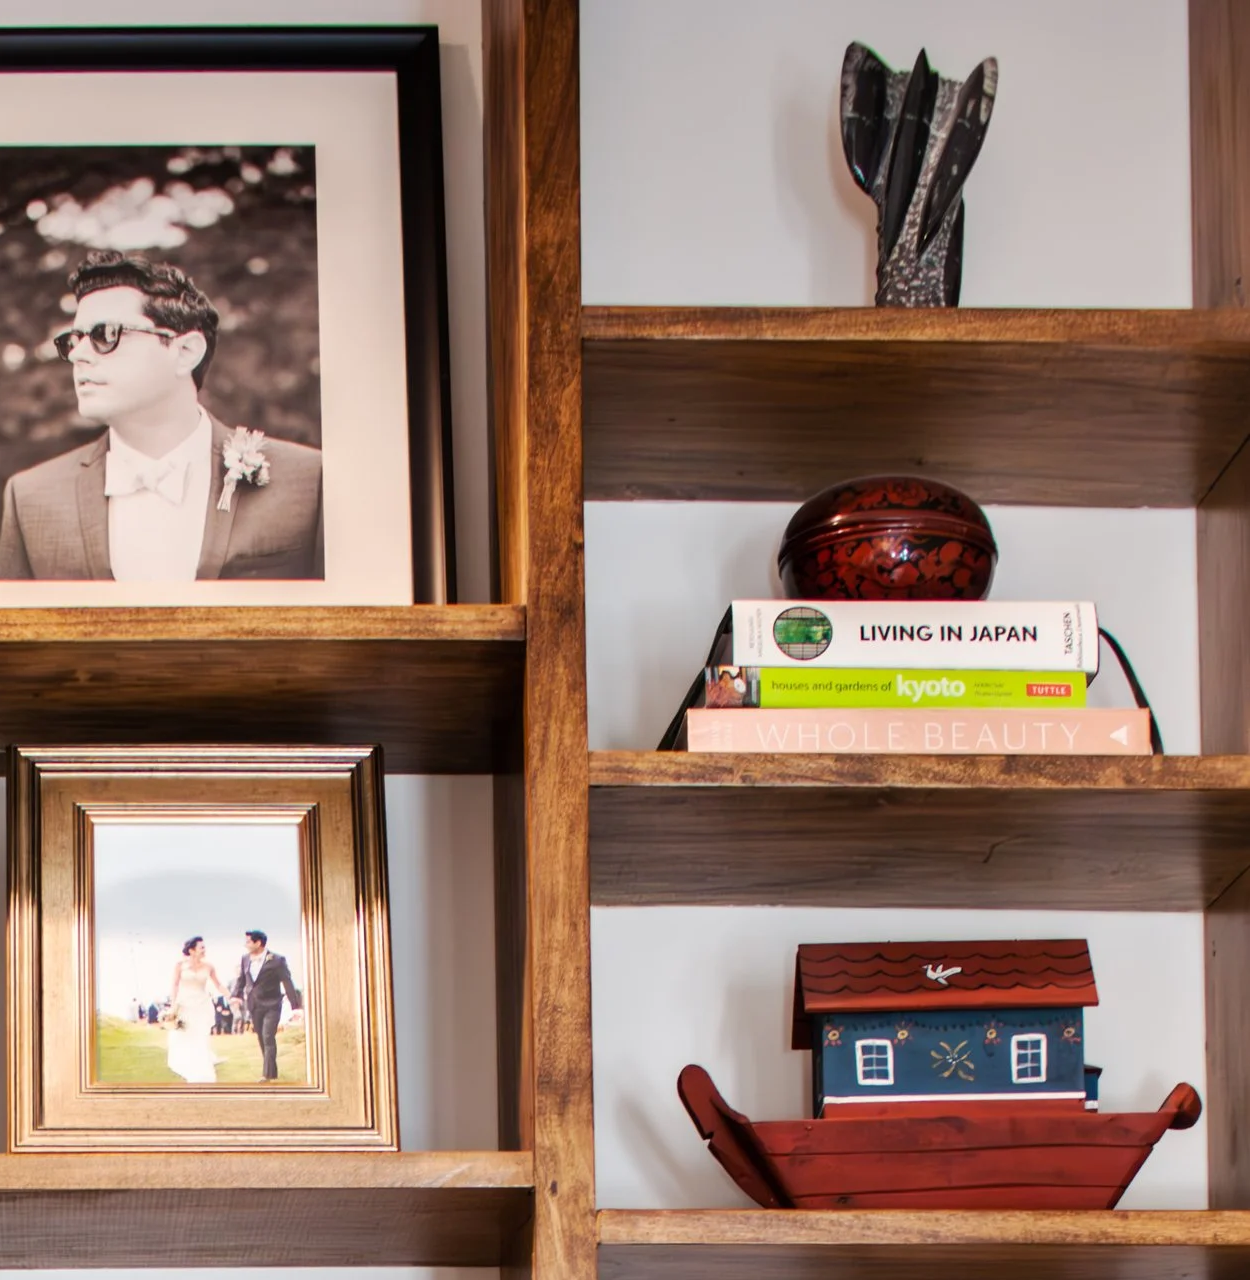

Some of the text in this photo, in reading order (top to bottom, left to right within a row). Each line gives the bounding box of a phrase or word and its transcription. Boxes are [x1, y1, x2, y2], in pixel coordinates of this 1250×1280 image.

[860, 625, 1038, 642] LIVING IN JAPAN
[1063, 612, 1073, 655] TASCHEN
[772, 681, 810, 691] houses
[812, 681, 832, 691] and
[835, 681, 878, 694] gardens
[881, 681, 892, 691] of
[896, 674, 966, 702] kyoto
[1032, 686, 1066, 695] TUTTLE
[756, 723, 905, 750] WHOLE
[925, 722, 1082, 750] BEAUTY
